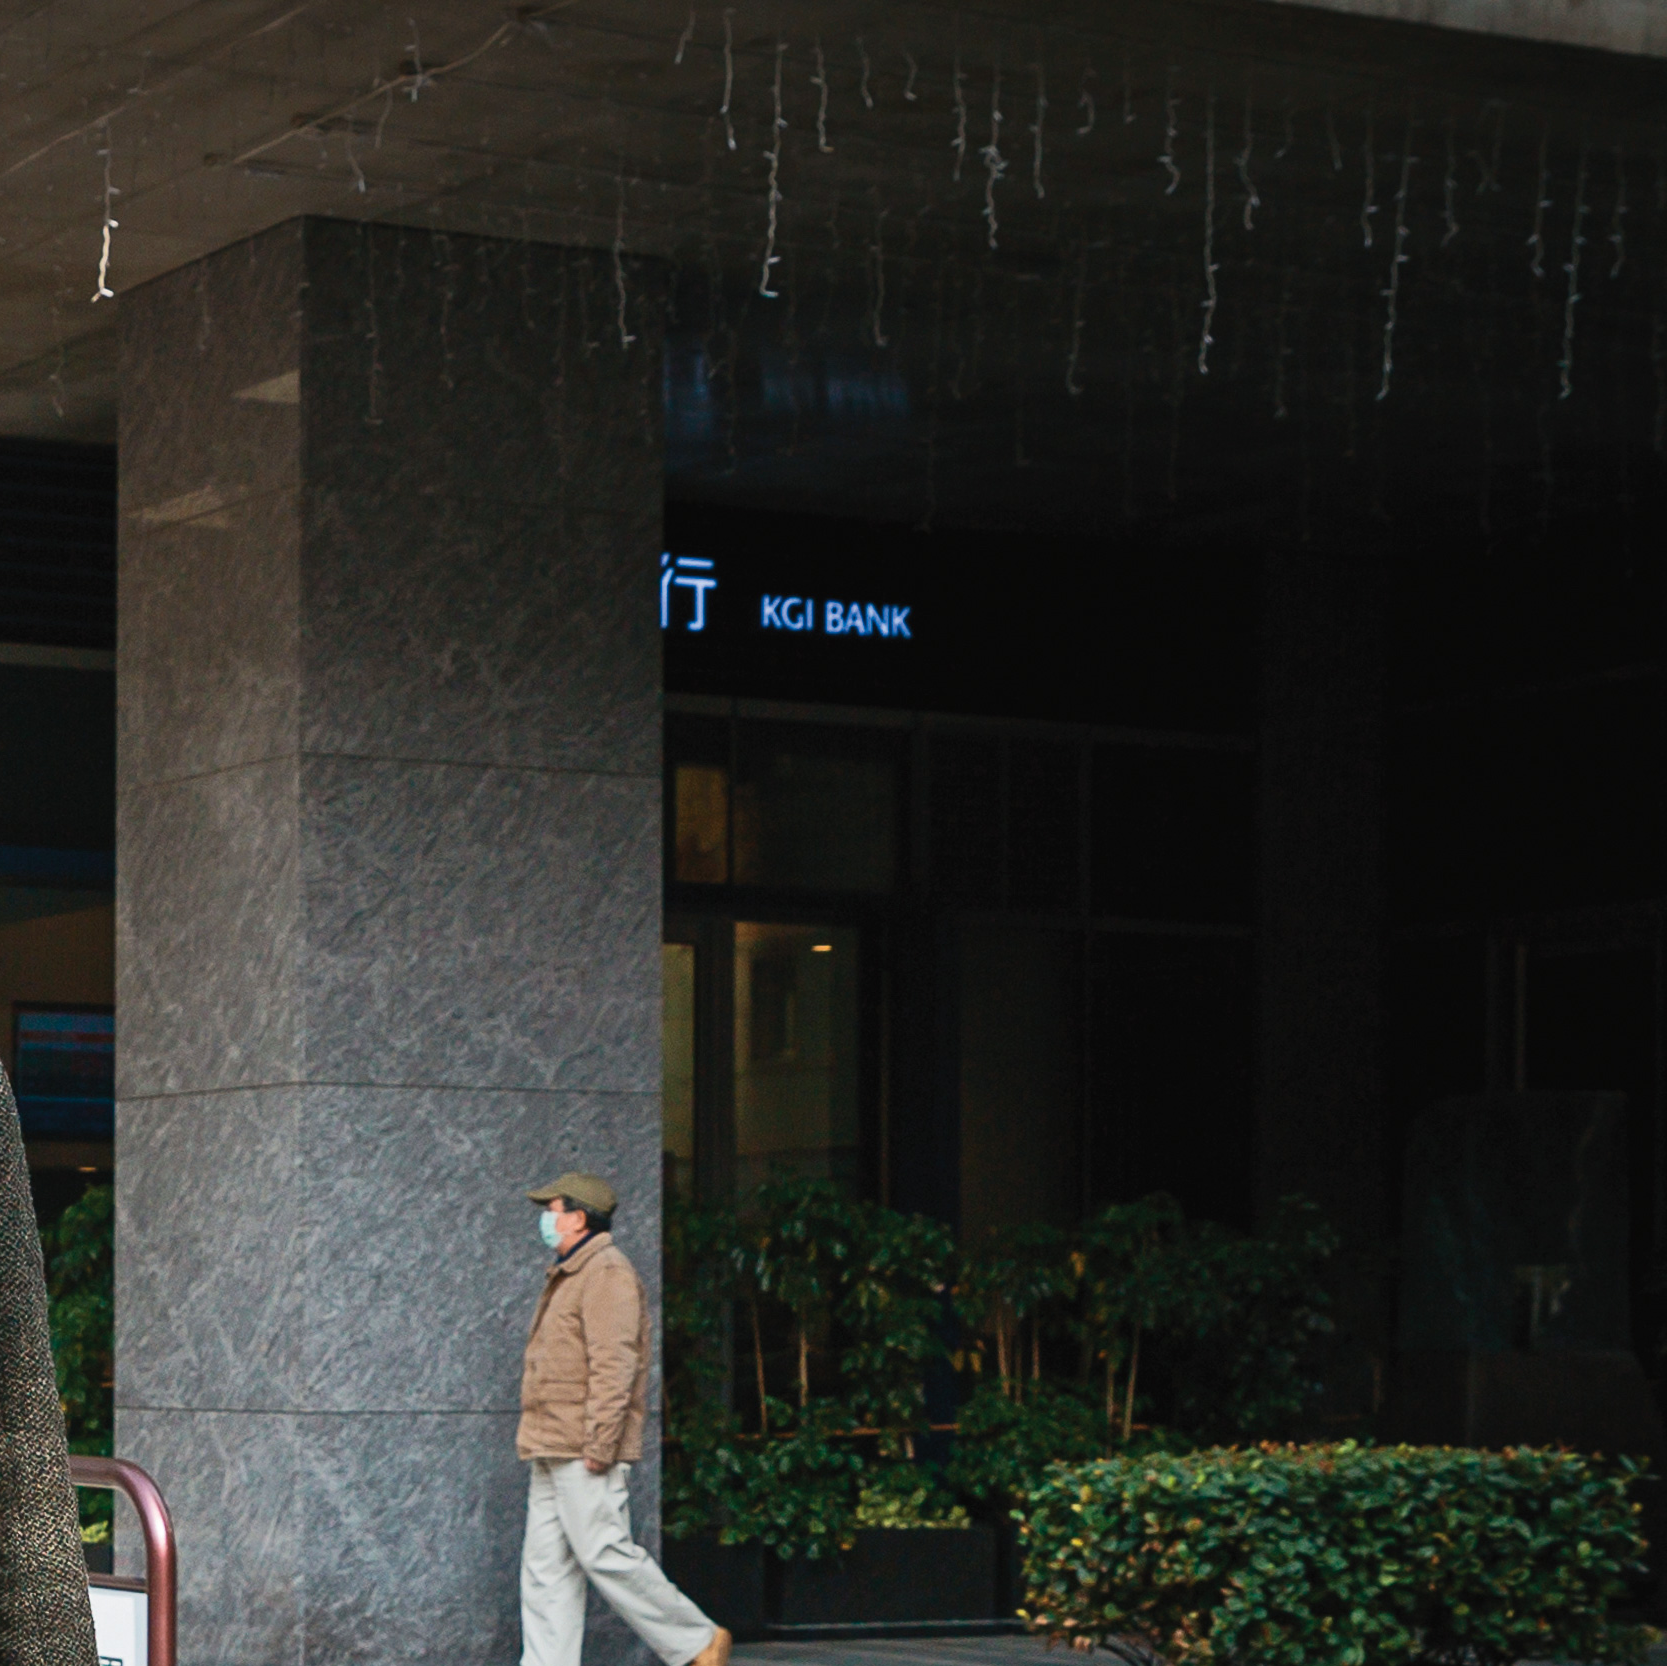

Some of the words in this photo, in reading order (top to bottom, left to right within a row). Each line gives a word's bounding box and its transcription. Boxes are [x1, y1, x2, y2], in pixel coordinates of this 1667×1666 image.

[660, 552, 718, 631] 行
[761, 594, 814, 631] KGI
[825, 600, 913, 639] BANK
